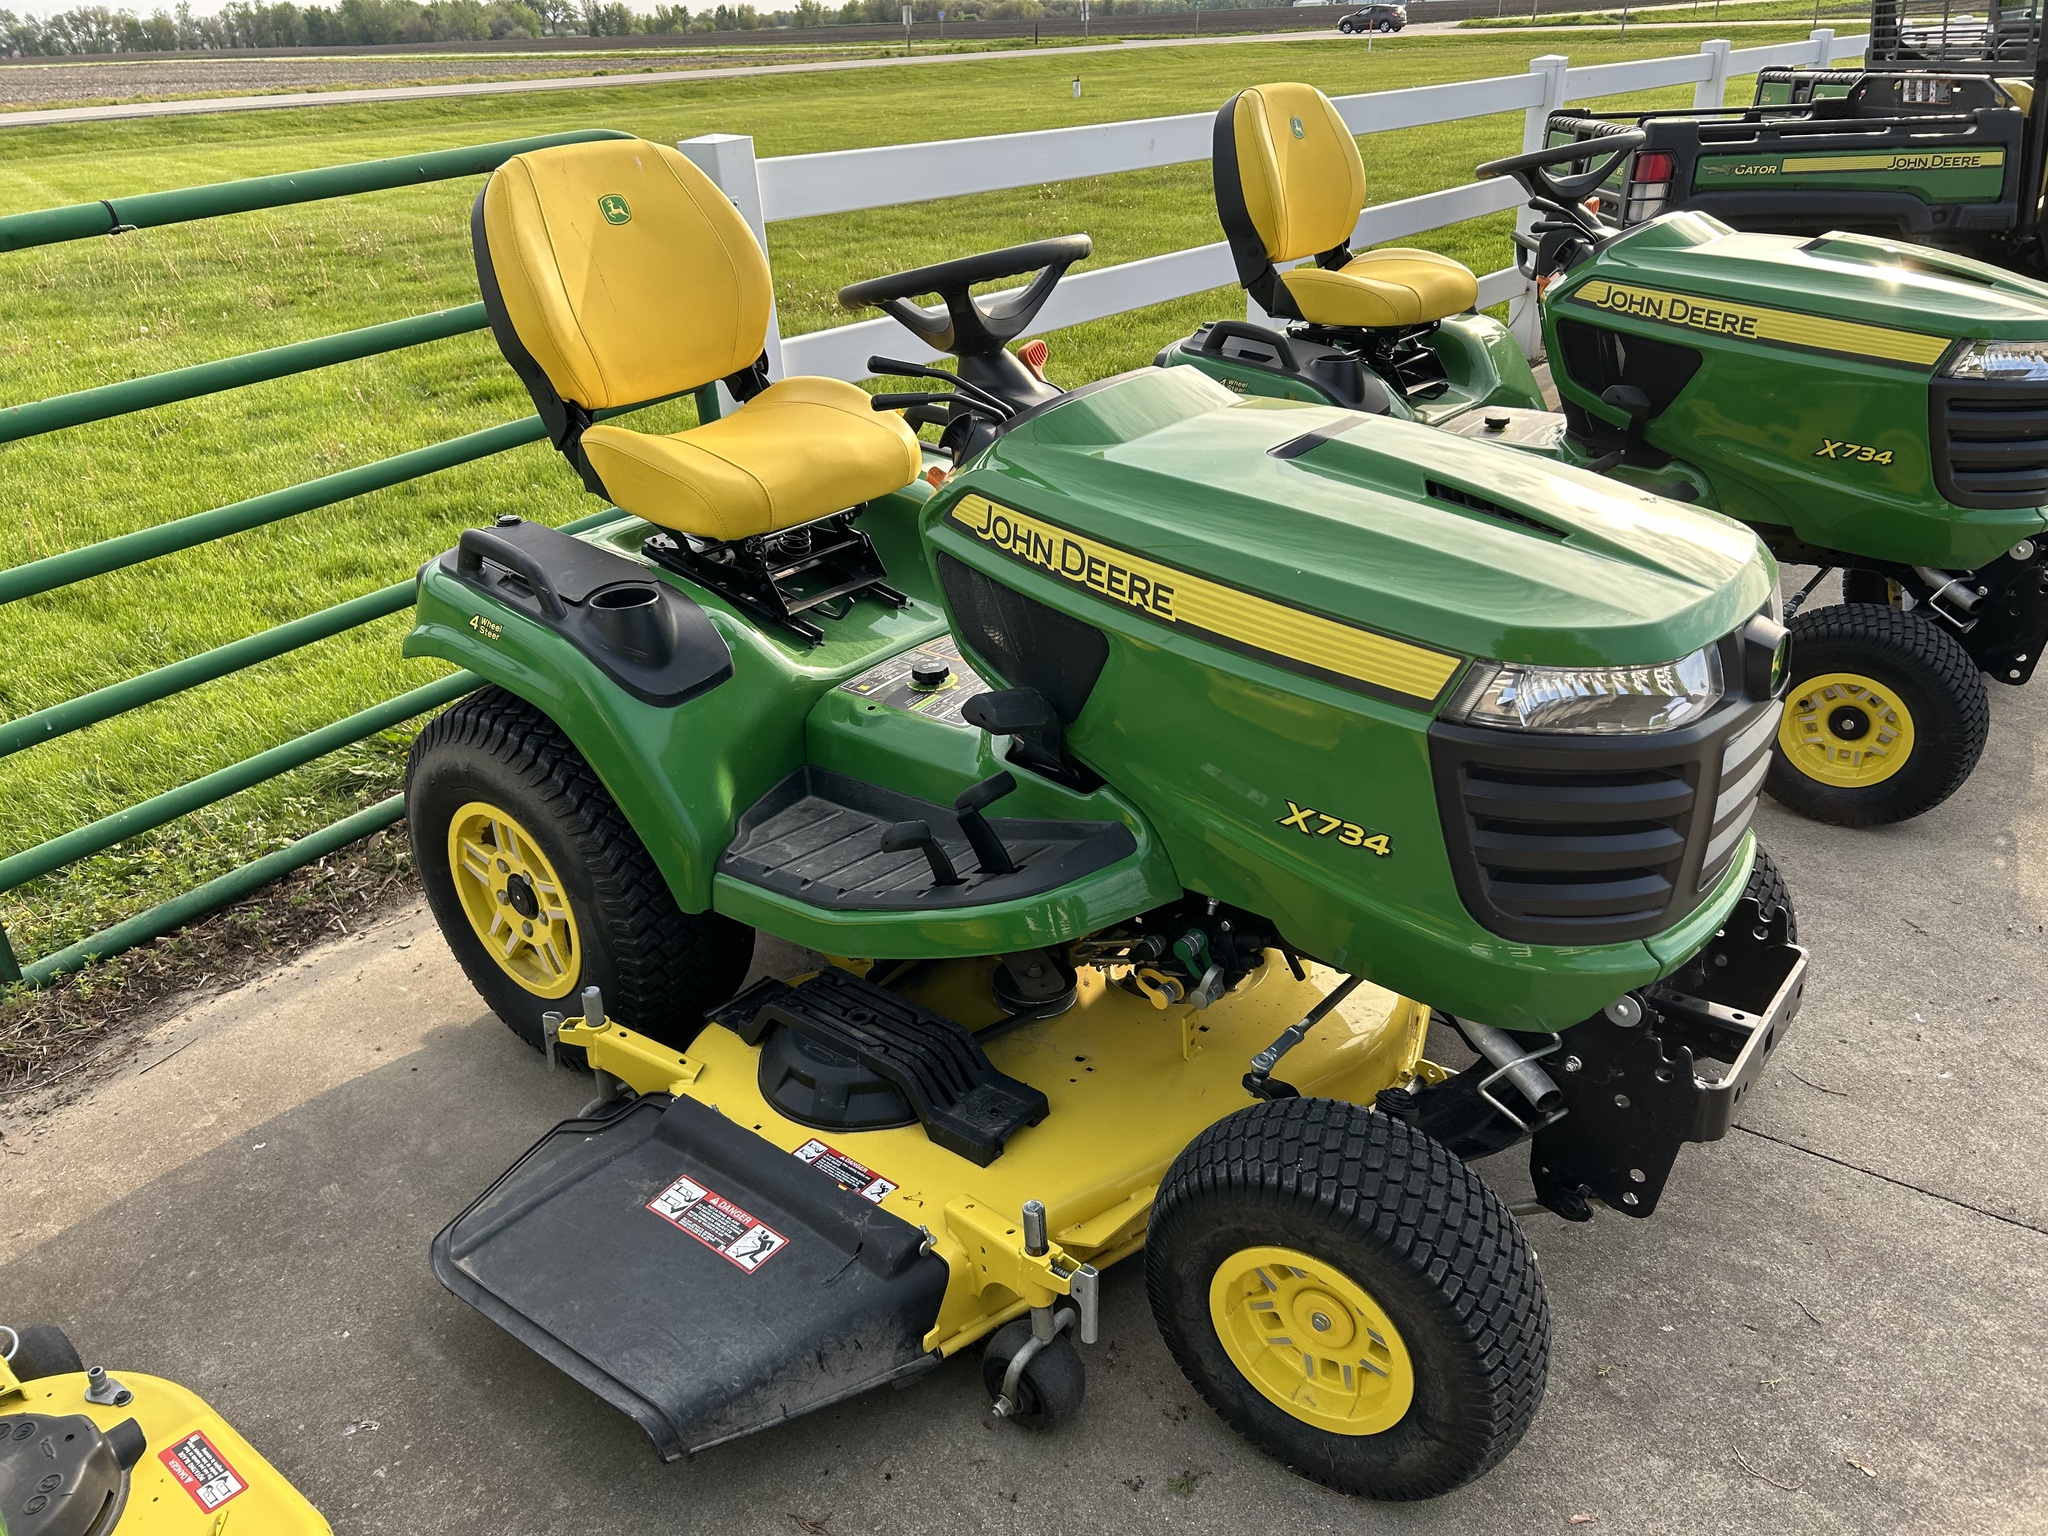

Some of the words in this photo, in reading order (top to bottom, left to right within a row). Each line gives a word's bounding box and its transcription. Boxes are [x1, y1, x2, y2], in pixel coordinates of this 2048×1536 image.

[1734, 164, 1777, 175] GATOR
[1887, 156, 1928, 170] JOHN
[1931, 155, 1981, 168] DEERE
[1597, 285, 1663, 319] JOHN
[1668, 299, 1758, 336] DEERE
[1227, 385, 1246, 393] Steer
[1228, 379, 1249, 388] Wheel
[1815, 439, 1894, 465] X734
[975, 504, 1055, 566] JOHN
[1060, 540, 1175, 616] DEERE
[469, 614, 480, 630] 4
[481, 617, 503, 633] Wheel
[479, 625, 500, 641] Steer
[1277, 801, 1393, 857] X734
[843, 1156, 869, 1173] DANGER
[717, 1201, 753, 1224] DANGER
[167, 1458, 189, 1480] DANGER
